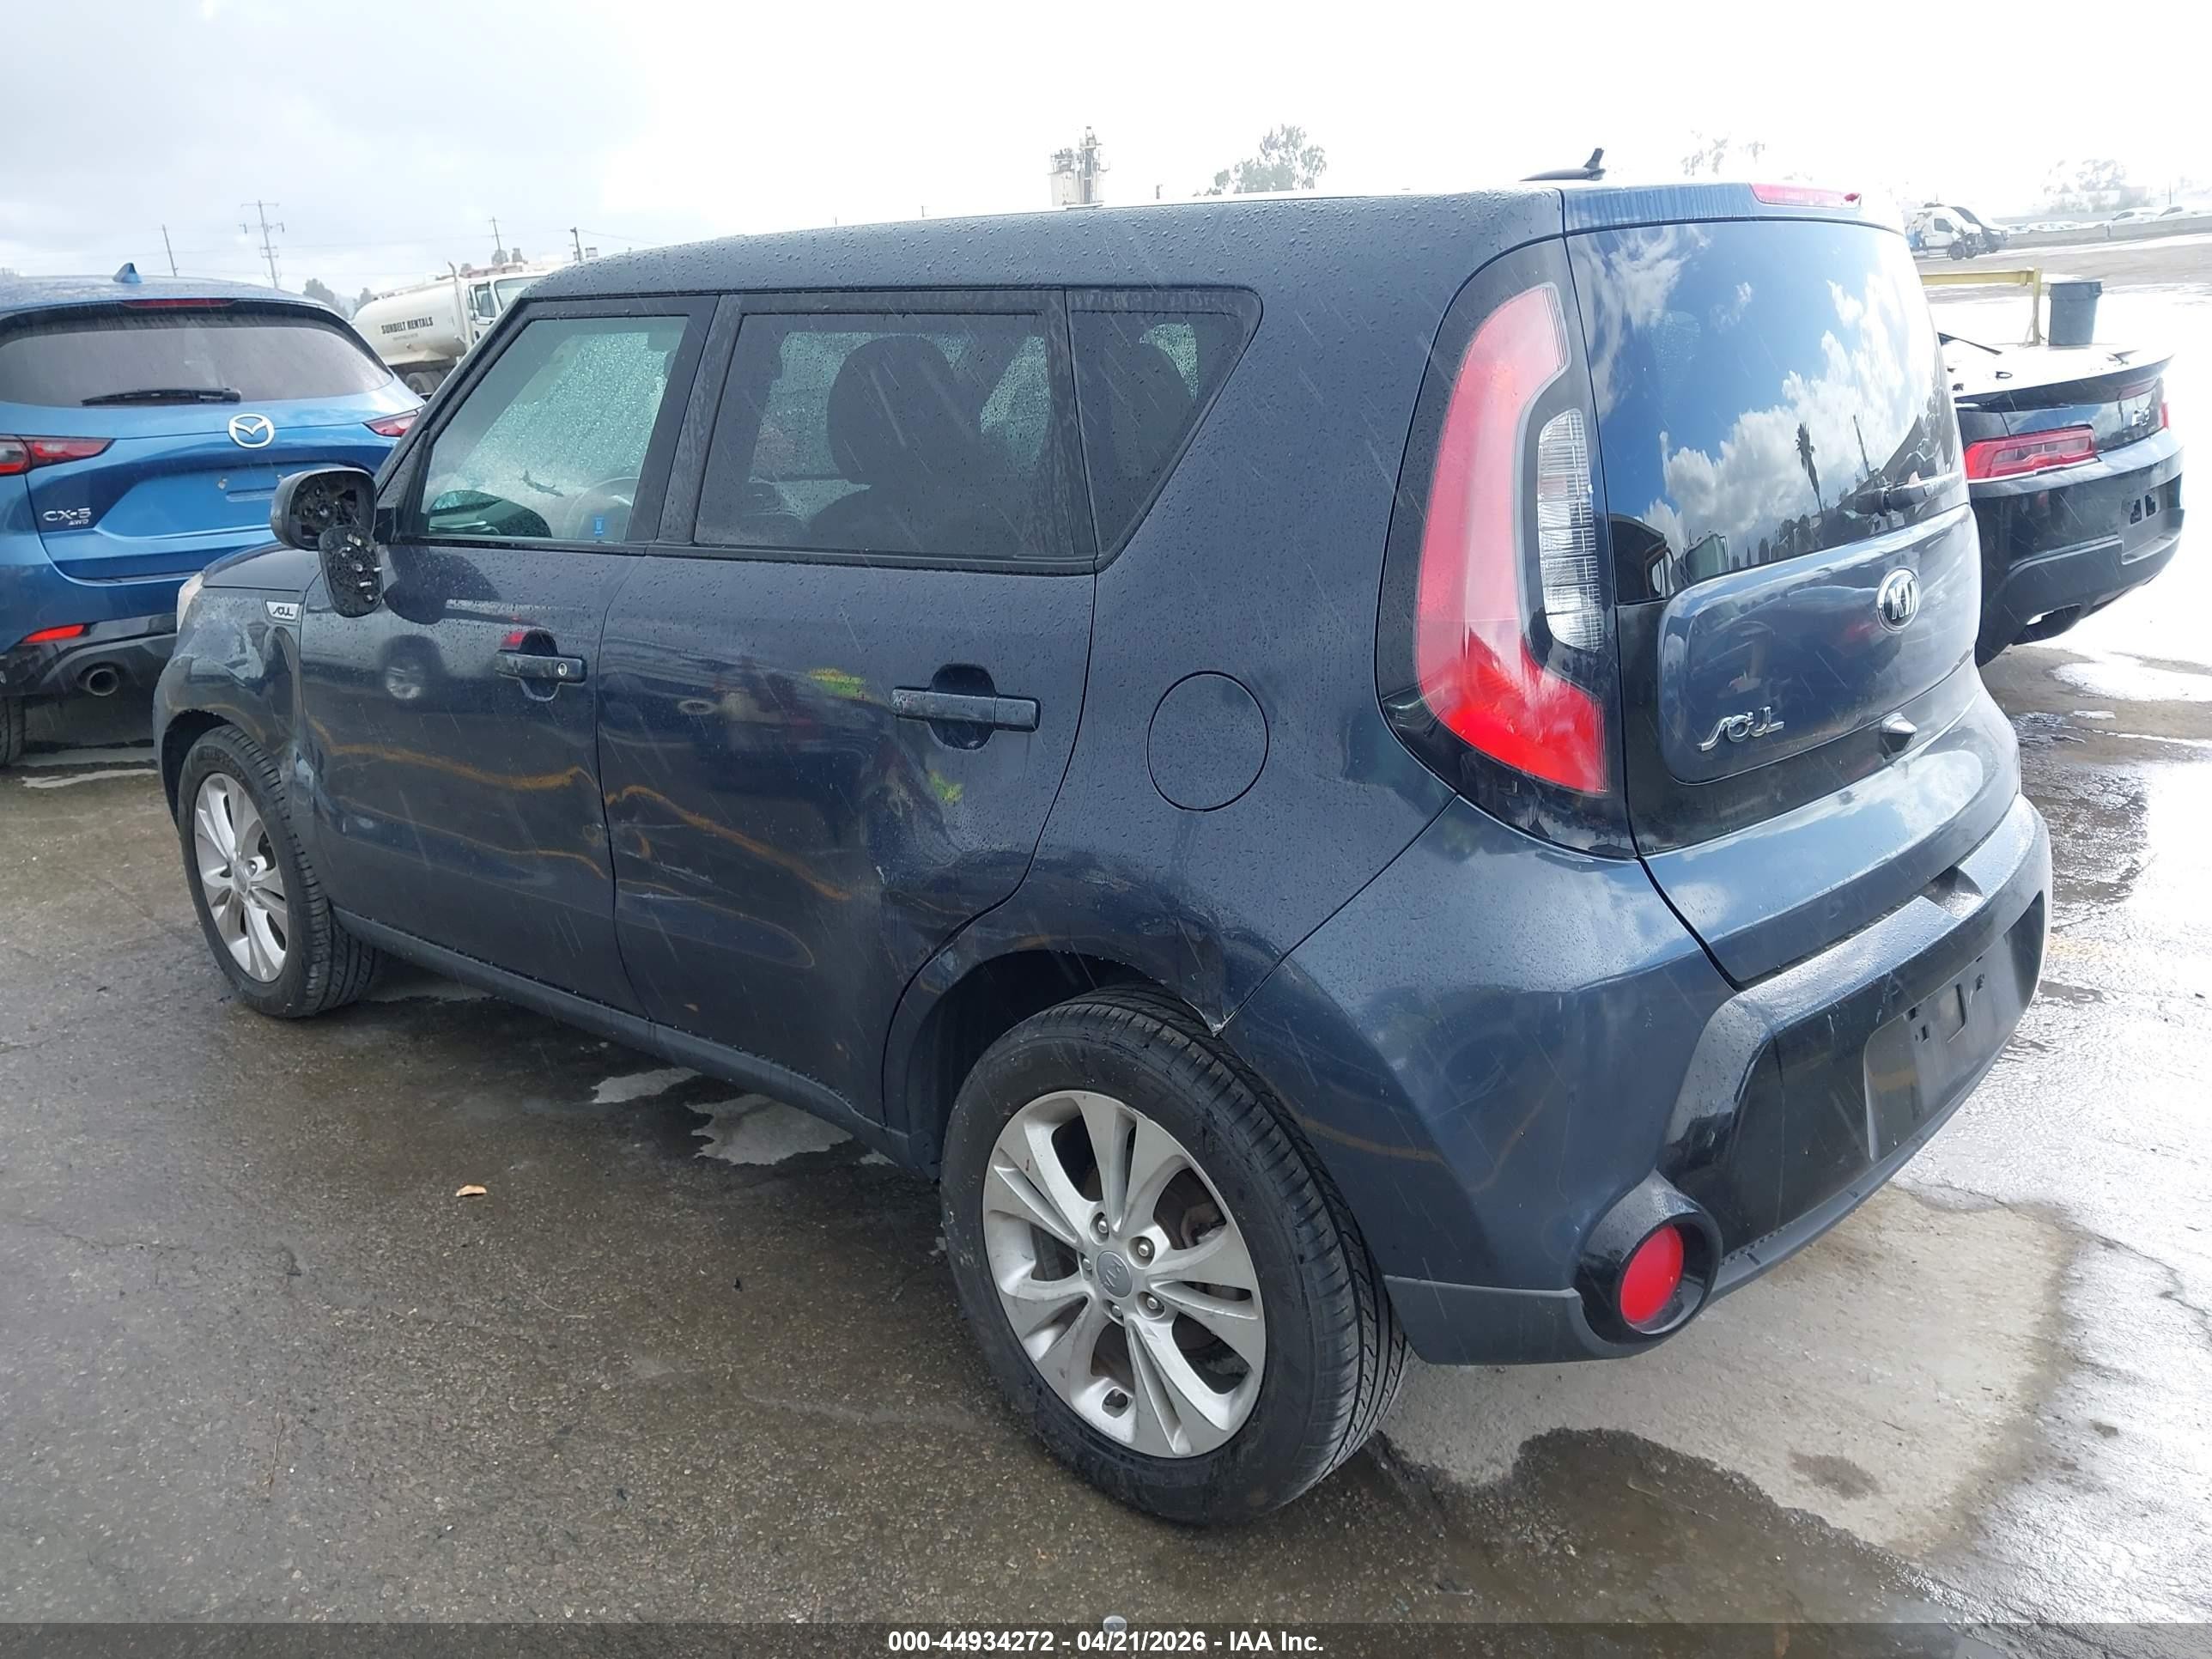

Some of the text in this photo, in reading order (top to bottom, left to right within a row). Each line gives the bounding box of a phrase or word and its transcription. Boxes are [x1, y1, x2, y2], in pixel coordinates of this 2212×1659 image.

[380, 316, 434, 335] SUNBELT RENTALS
[43, 507, 92, 522] CX-5
